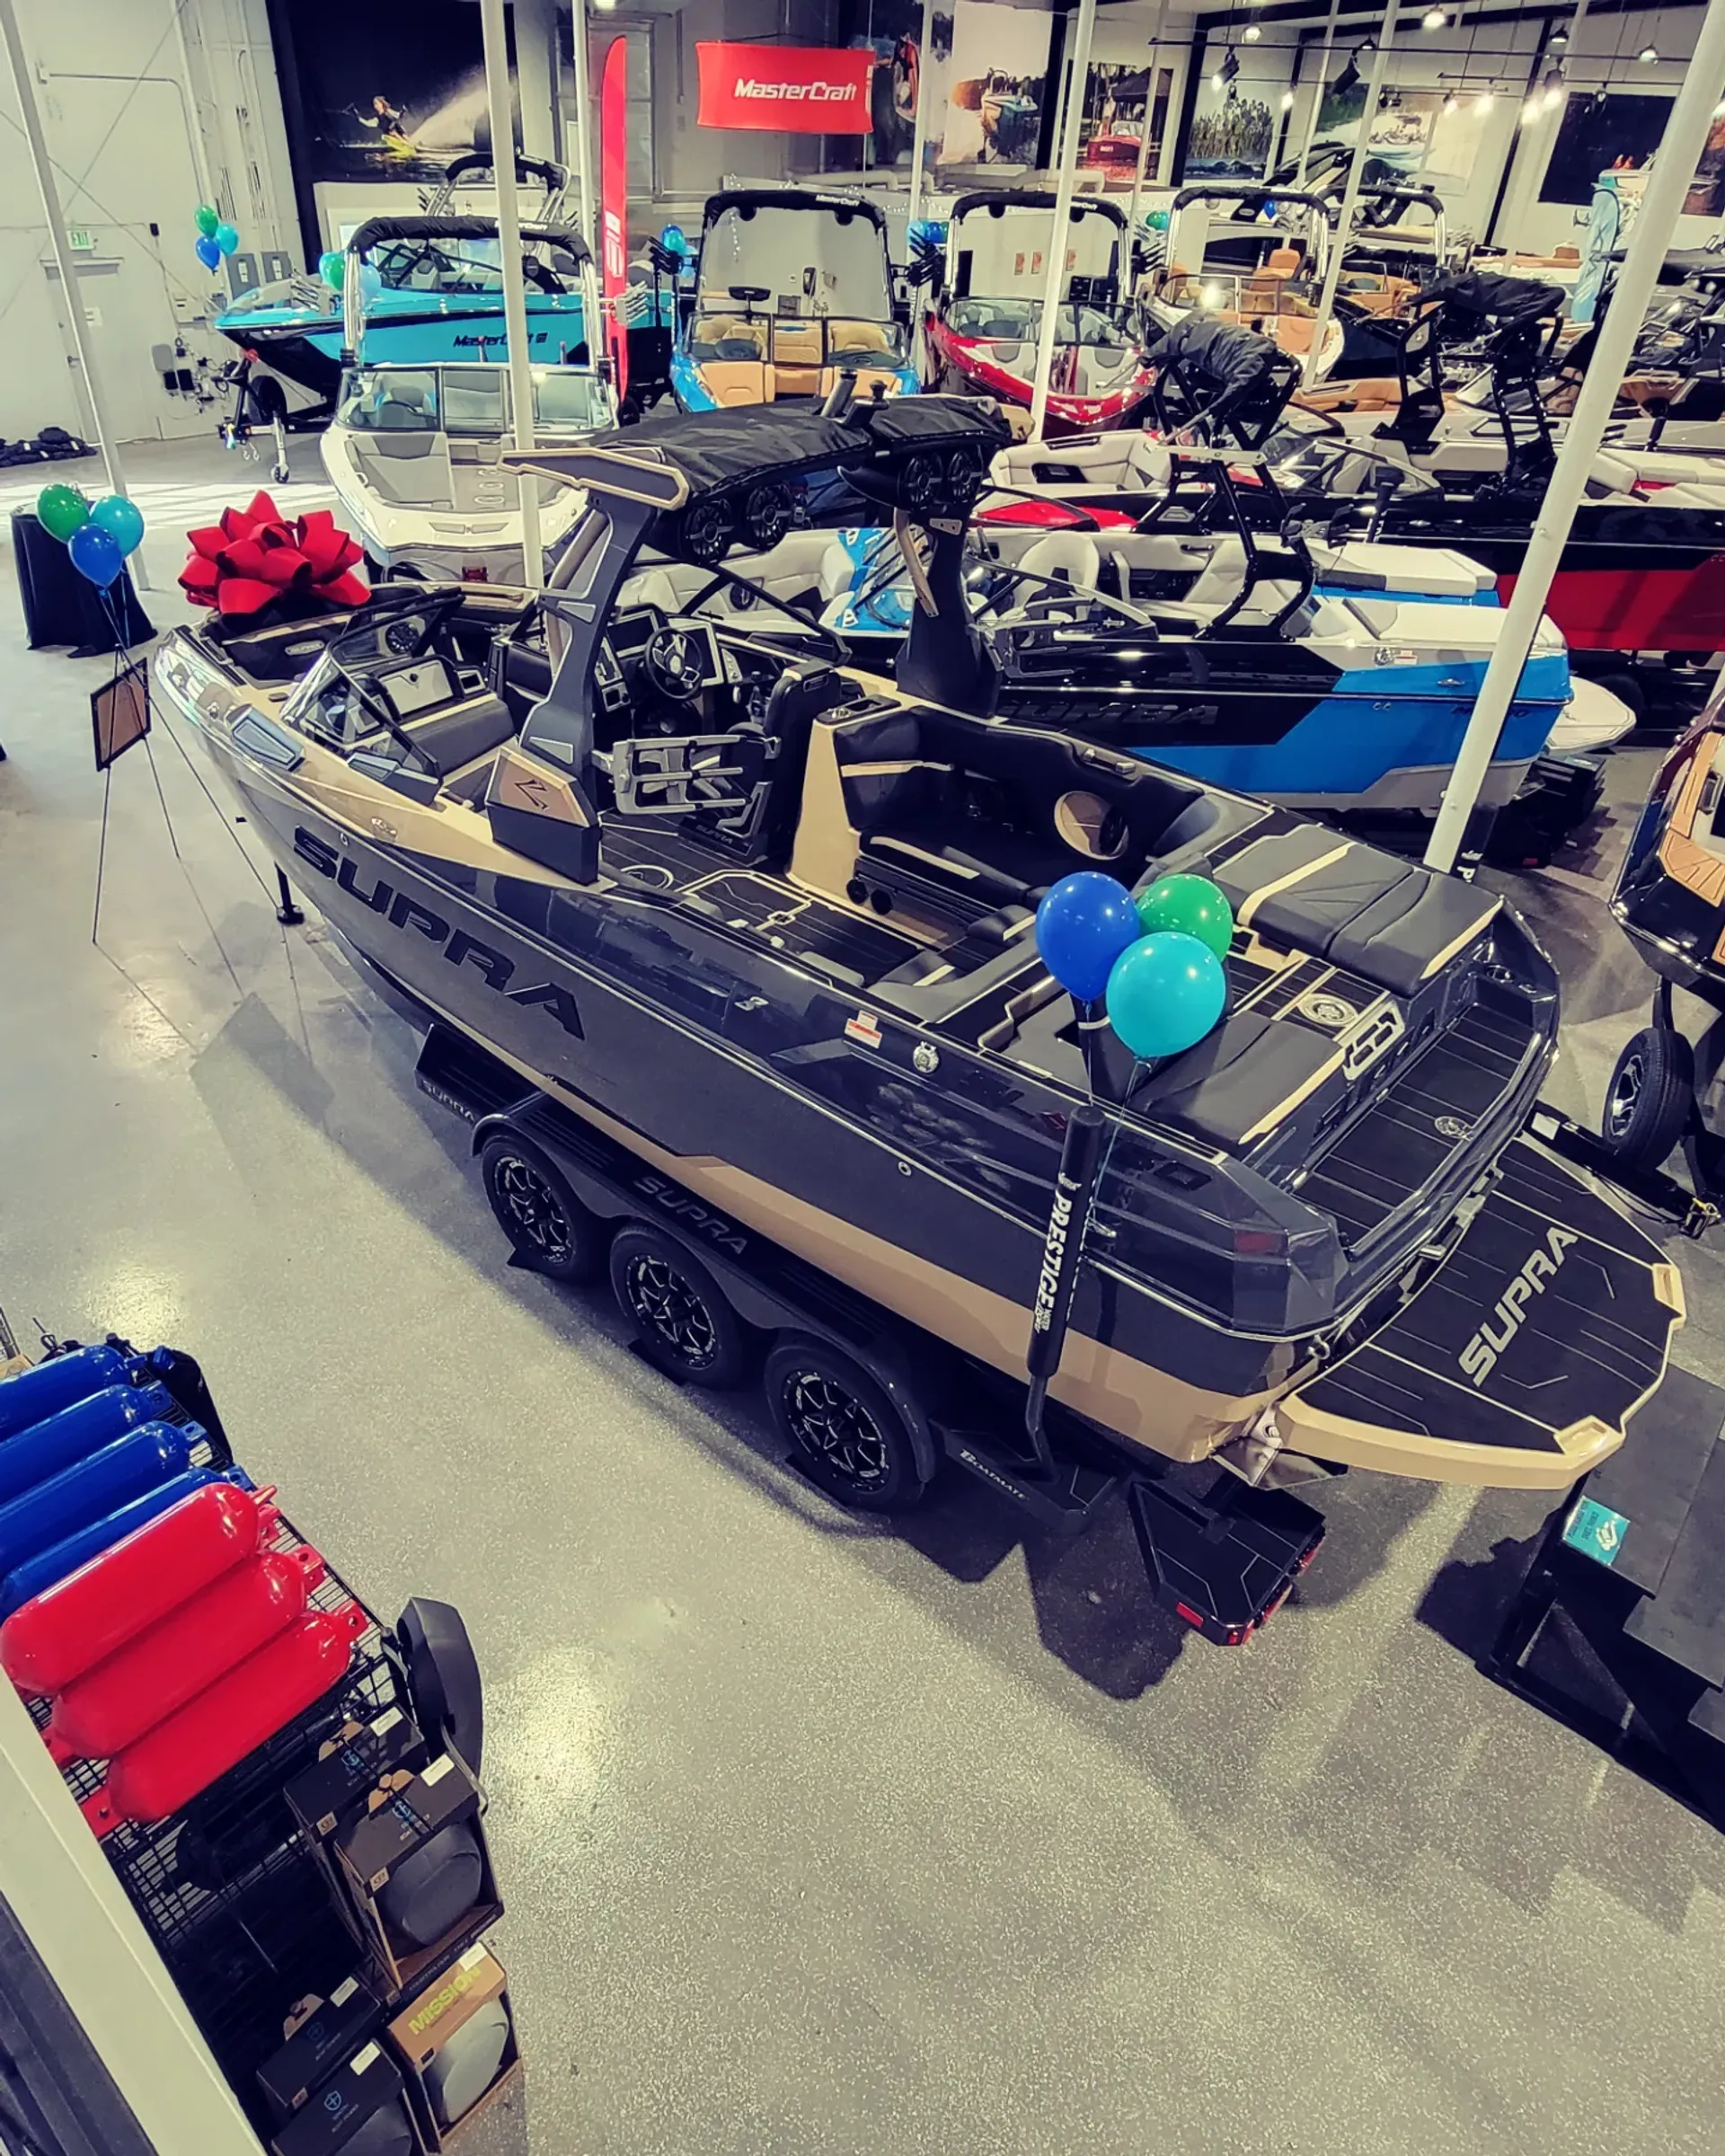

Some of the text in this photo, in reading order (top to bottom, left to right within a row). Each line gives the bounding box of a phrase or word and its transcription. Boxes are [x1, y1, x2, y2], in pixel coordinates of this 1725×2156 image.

[734, 78, 857, 101] MasterCraft
[294, 825, 584, 1040] SUPRA
[421, 1079, 477, 1124] SUPRA
[633, 1175, 749, 1256] SUPRA
[1039, 1189, 1073, 1309] PRESTIGE
[1459, 1226, 1579, 1387] SUPRA
[959, 1448, 1030, 1501] BOATMATE
[408, 1965, 482, 2036] MISSION
